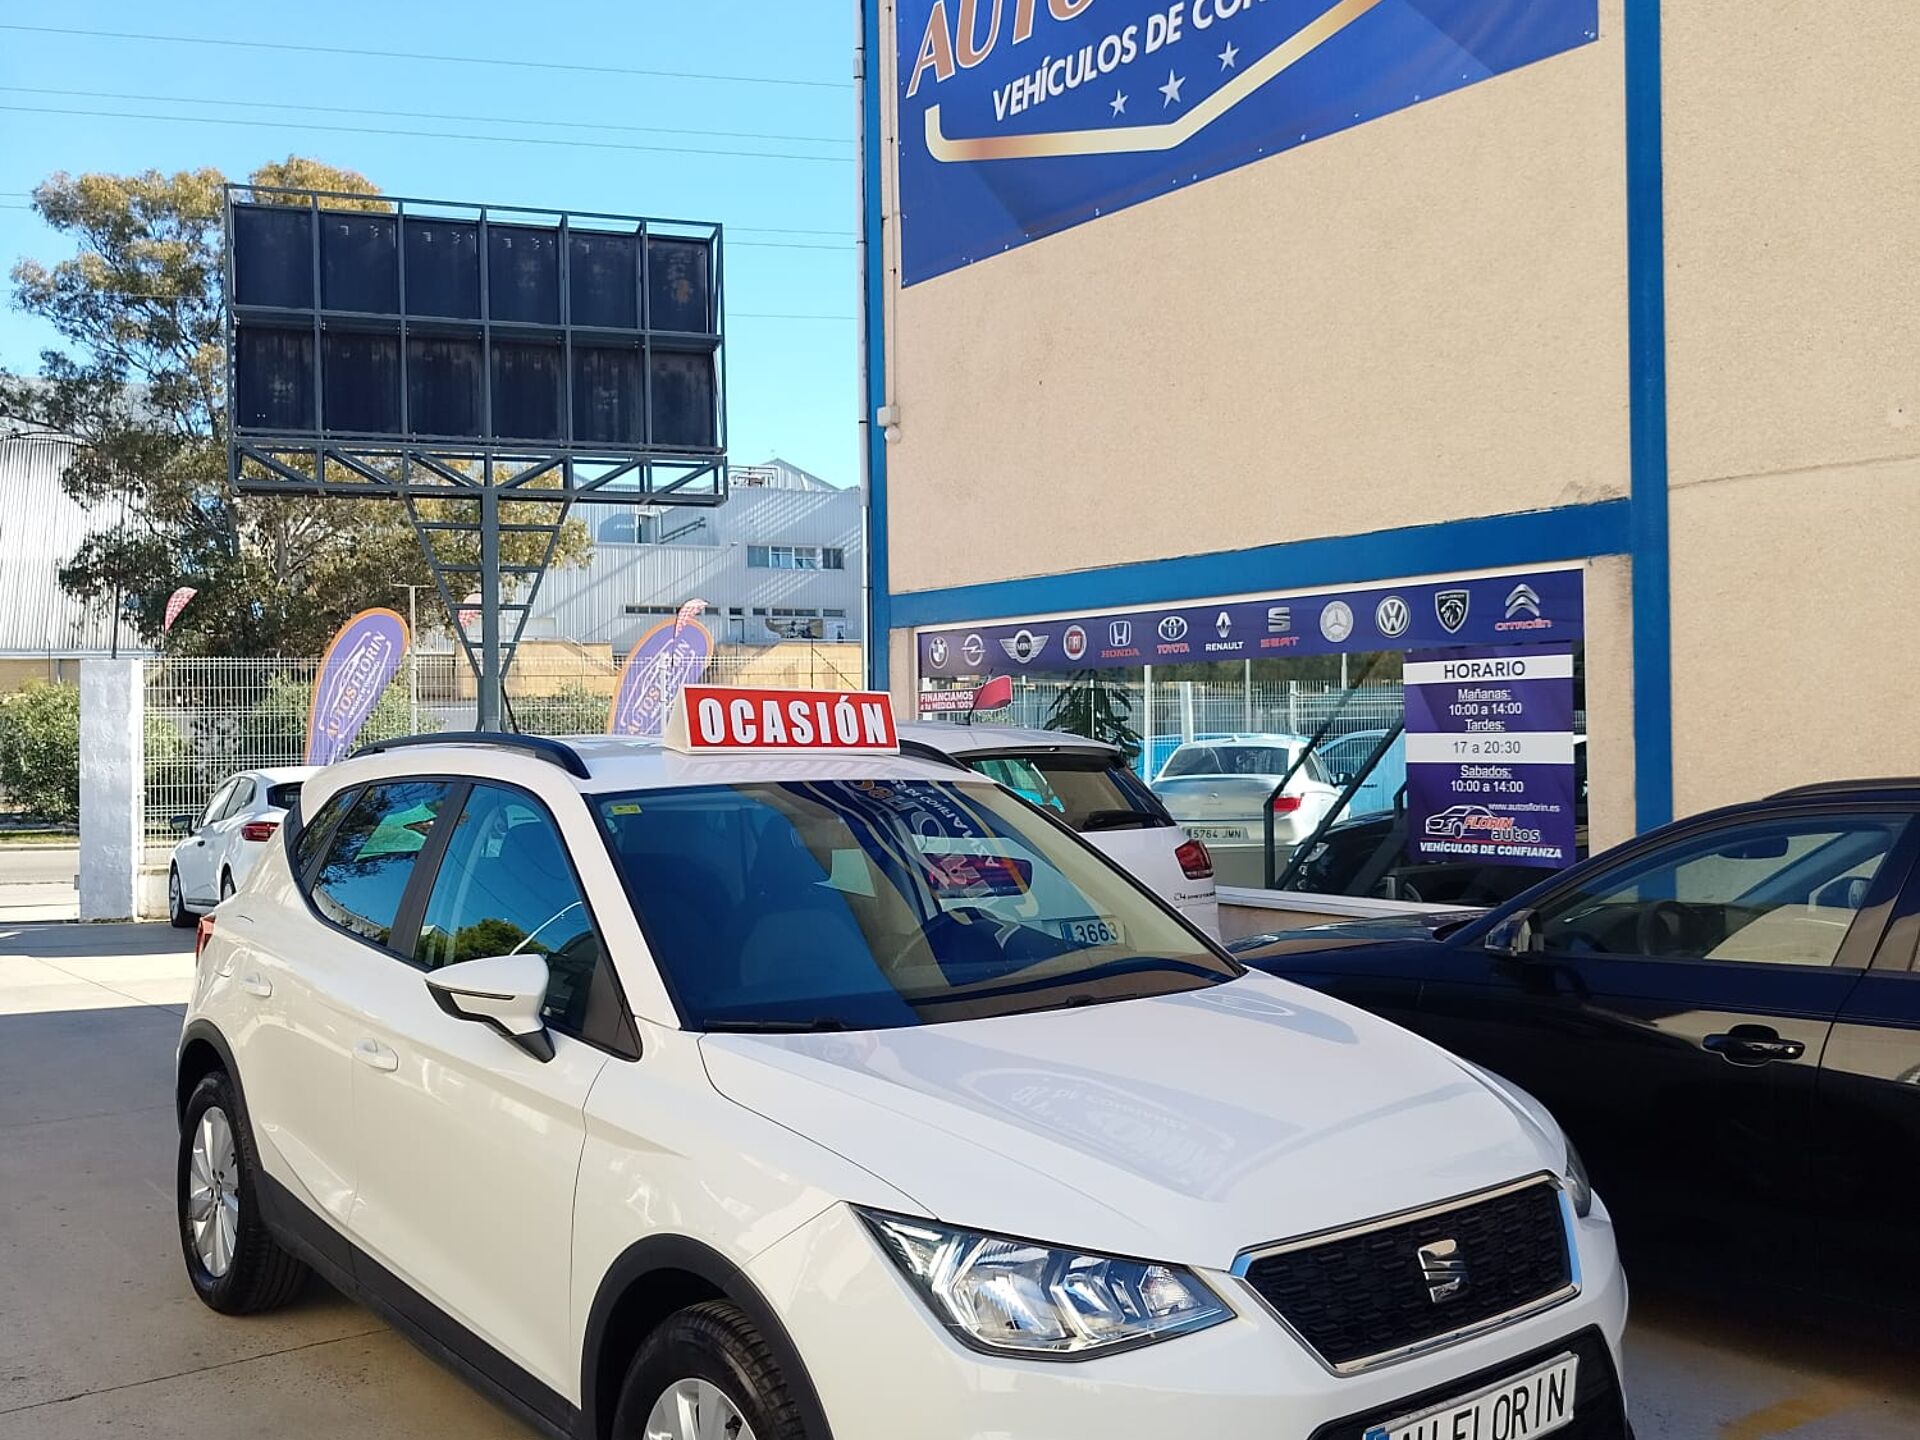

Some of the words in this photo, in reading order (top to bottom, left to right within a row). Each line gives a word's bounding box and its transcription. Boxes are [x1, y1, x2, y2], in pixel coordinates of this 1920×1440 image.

[993, 25, 1138, 121] VEHÍCULOS
[1145, 1, 1184, 54] DE
[1192, 0, 1267, 29] CO
[1156, 643, 1190, 654] TOYOTA
[1205, 641, 1245, 652] RENAULT
[1260, 636, 1300, 648] SEAT
[1101, 647, 1141, 658] HONDA
[351, 631, 386, 688] FLORIN
[1444, 660, 1526, 679] HORARIO
[920, 691, 974, 703] FINANCIAMOS
[1457, 688, 1512, 701] Mañanas:
[1449, 704, 1478, 716] 10:00
[1481, 706, 1489, 715] a
[1491, 702, 1522, 714] 14:00
[698, 695, 889, 745] OCASIÓN
[1465, 718, 1505, 731] Tardes:
[1454, 741, 1467, 753] 17
[1472, 744, 1480, 753] a
[1484, 741, 1521, 754] 20:30
[1460, 765, 1512, 778] Sabados:
[1451, 780, 1480, 792] 10:00
[1483, 783, 1491, 792] a
[1493, 781, 1524, 793] 14:00
[1463, 816, 1515, 830] FLORIN
[1193, 829, 1218, 839] 5764
[1491, 826, 1541, 842] autos
[1420, 841, 1478, 855] VEHÍCULOS
[1480, 844, 1495, 855] DE
[1497, 844, 1563, 859] CONFIANZA
[1074, 922, 1119, 944] 3663
